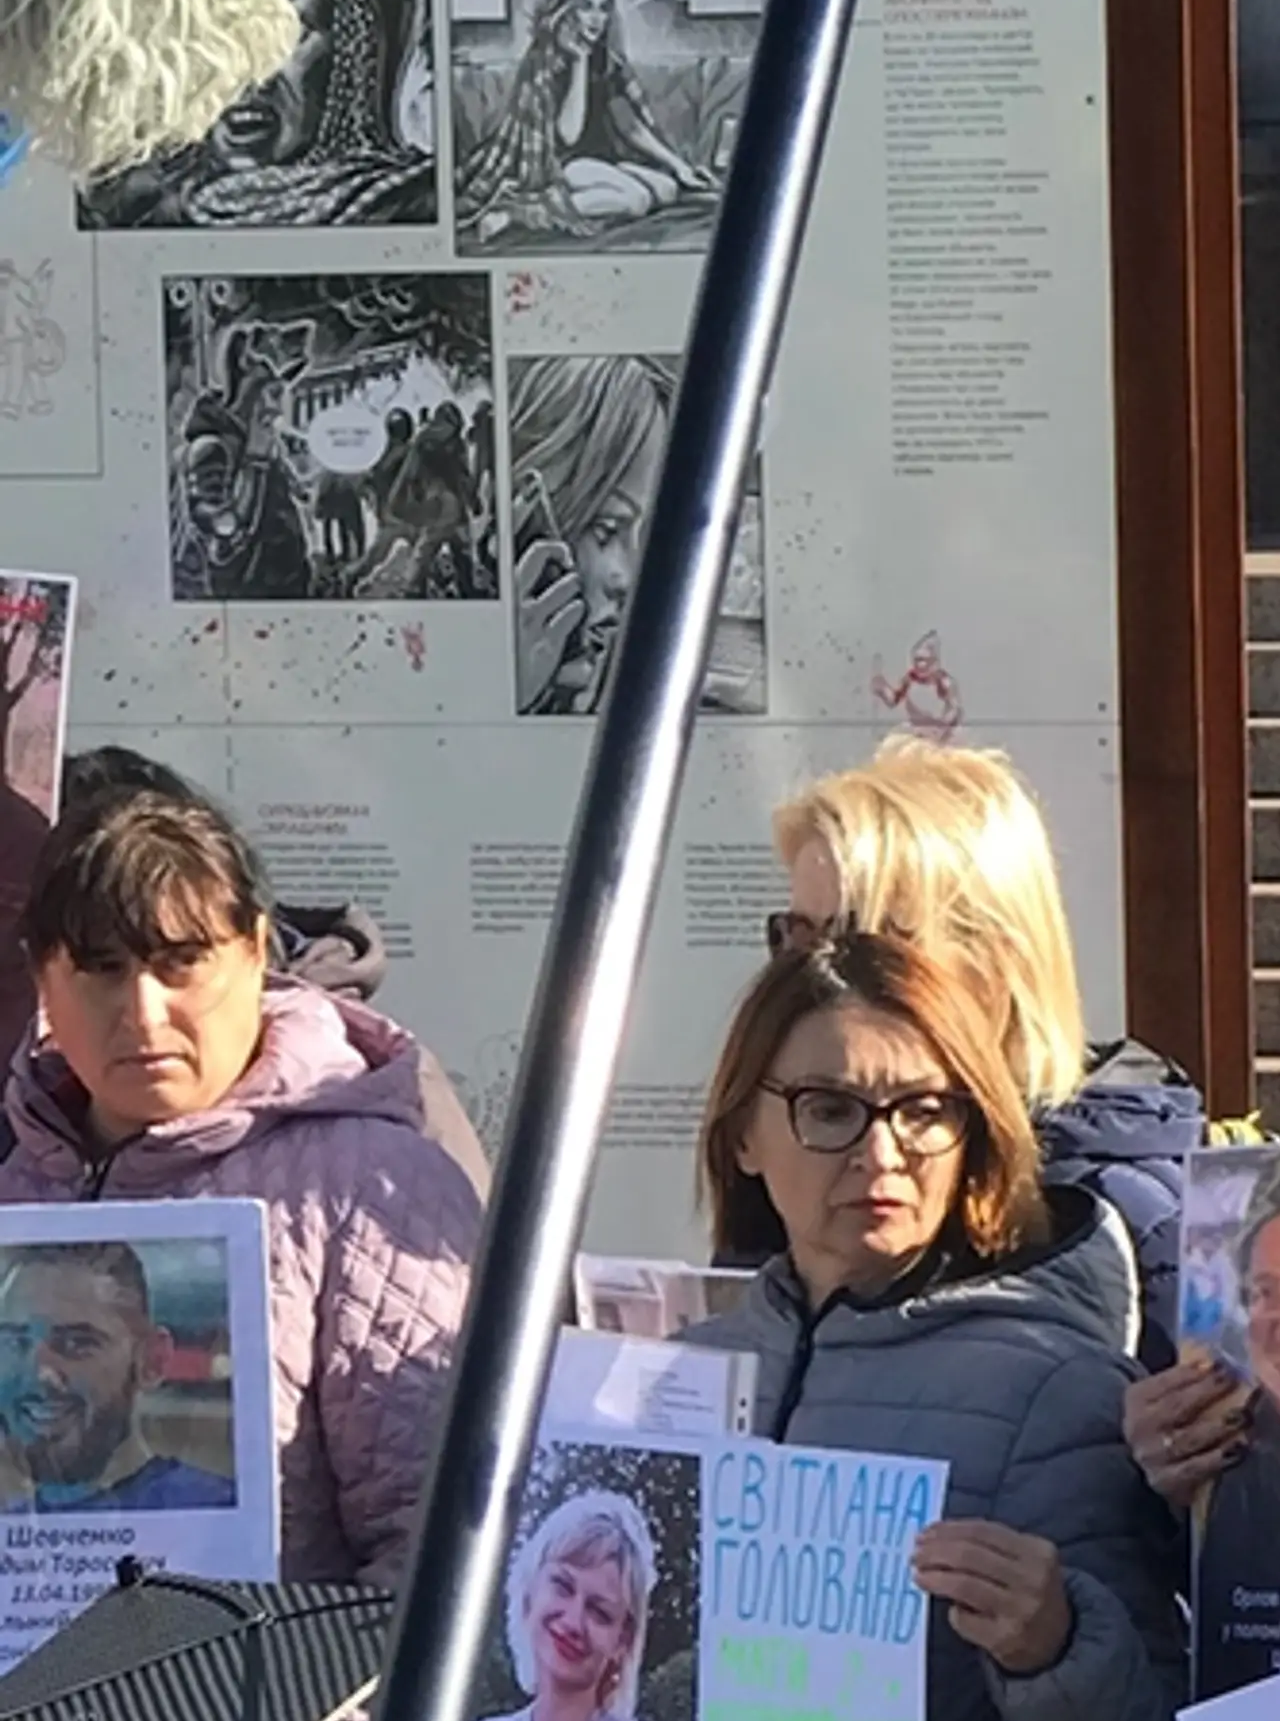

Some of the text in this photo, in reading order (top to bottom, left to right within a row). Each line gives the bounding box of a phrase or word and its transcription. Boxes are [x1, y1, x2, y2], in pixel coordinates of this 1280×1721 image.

[7, 1526, 136, 1548] Шевченко
[713, 1452, 929, 1548] СВІТЛАНА
[712, 1537, 923, 1644] ГОЛОВАНЬ
